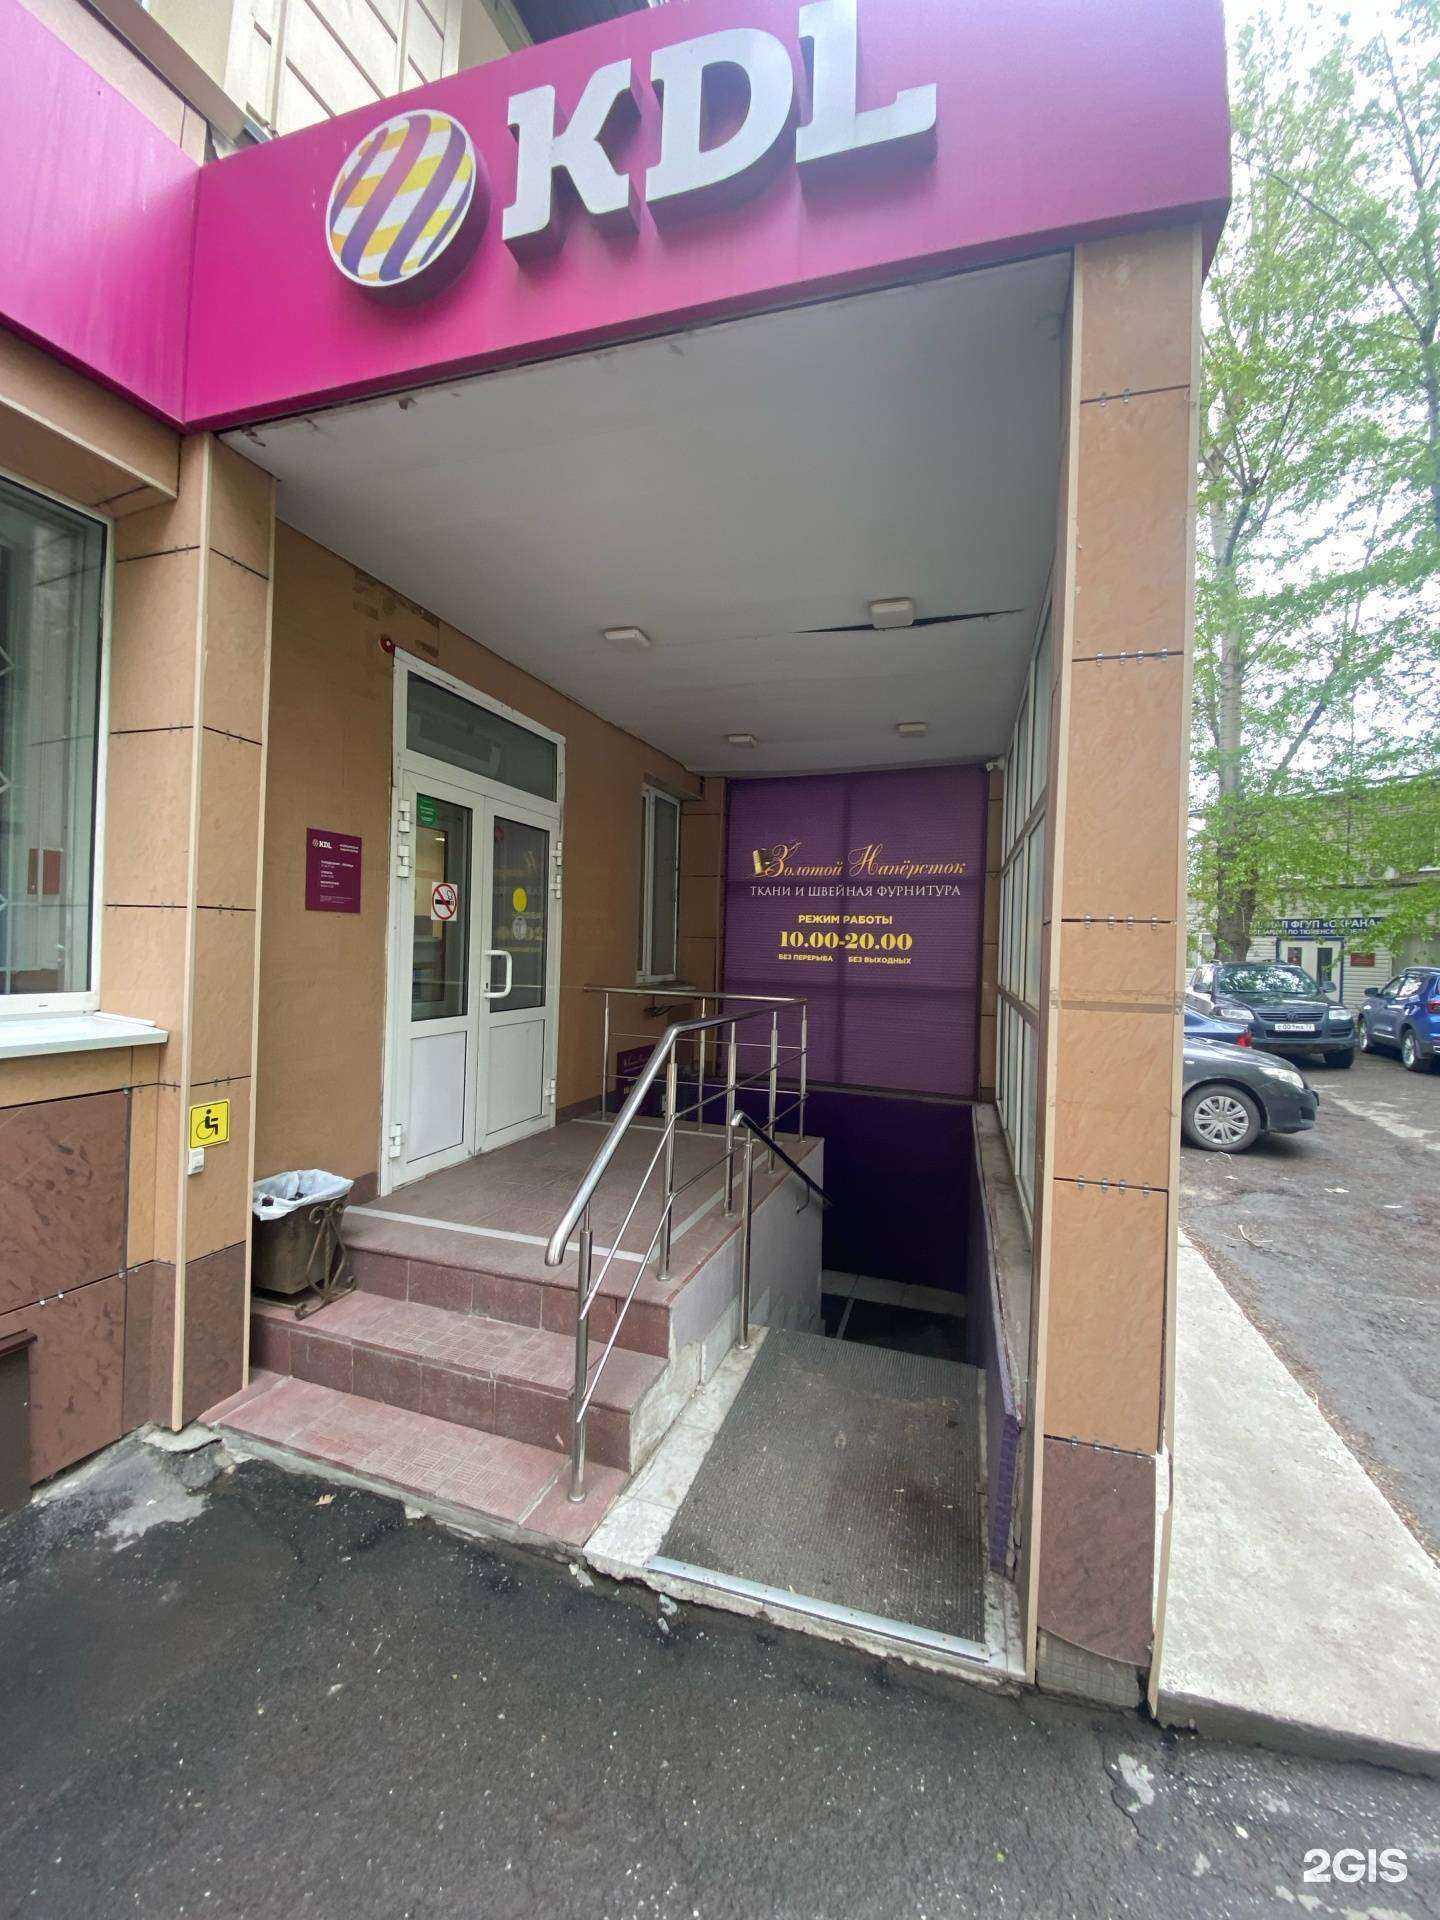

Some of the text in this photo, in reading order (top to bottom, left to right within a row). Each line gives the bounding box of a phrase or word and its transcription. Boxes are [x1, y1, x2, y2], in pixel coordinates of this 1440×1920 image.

[502, 0, 937, 241] KDL
[319, 840, 333, 849] KDL
[753, 842, 964, 879] Золотой Напёрсток
[750, 884, 961, 897] ТКАНИ И ШВЕЙНАЯ ФУРНИТУРА
[798, 914, 893, 925] РЕЖИМ РАБОТЫ
[779, 931, 913, 950] 10.00-20.00
[778, 953, 792, 961] БЕЗ
[793, 954, 833, 962] ПЕРЕРЫВА
